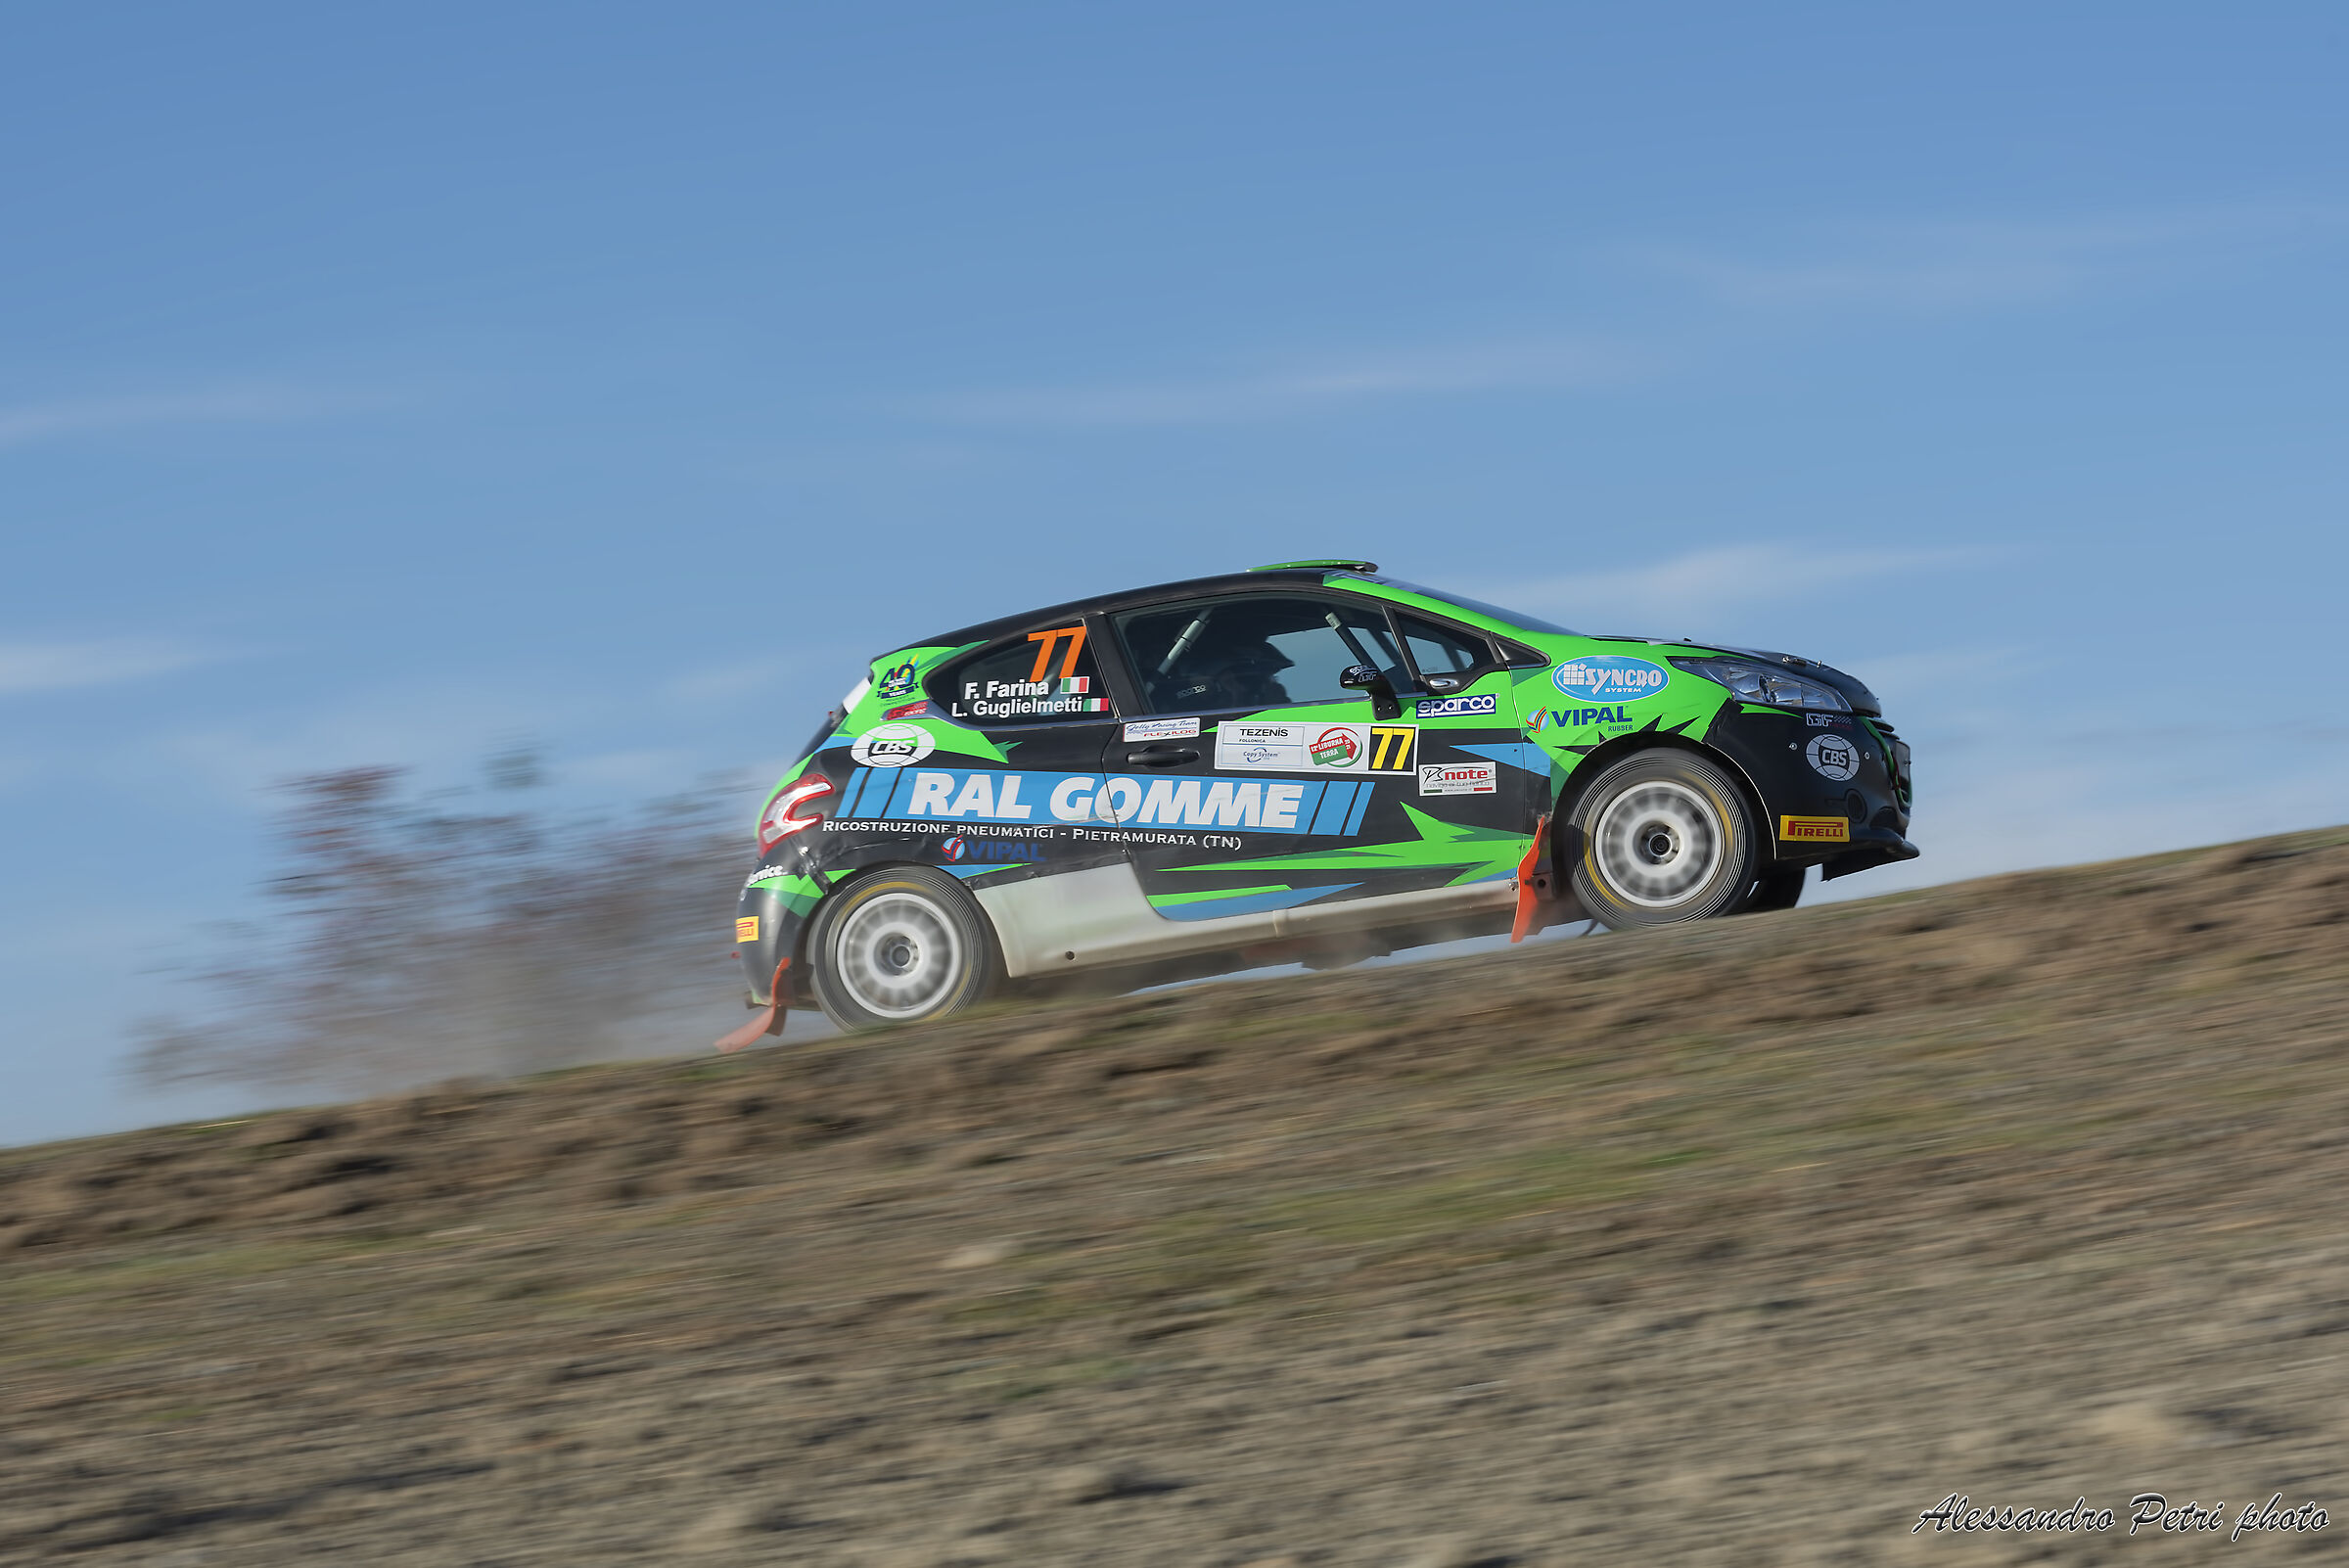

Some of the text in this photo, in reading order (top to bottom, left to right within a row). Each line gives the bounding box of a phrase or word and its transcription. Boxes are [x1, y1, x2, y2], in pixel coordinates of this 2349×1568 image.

[1028, 626, 1086, 682] 77
[964, 679, 1049, 700] F. Farina
[1585, 668, 1663, 695] SYNCRO
[951, 696, 1082, 718] L. Guglielmetti
[1417, 696, 1495, 717] sparco
[1551, 706, 1633, 728] VIPAL
[871, 740, 915, 755] CBS
[1371, 728, 1415, 770] 77
[1821, 749, 1847, 766] CBS
[907, 772, 1305, 829] RAL GOMME
[822, 821, 950, 833] RICOSTRUZIONE
[956, 824, 1054, 839] PNEUMATICI
[1073, 828, 1197, 846] PIETRAMURATA
[1203, 834, 1242, 851] (TN)
[1787, 820, 1843, 837] PIRELLI
[966, 840, 1047, 861] VIPAL
